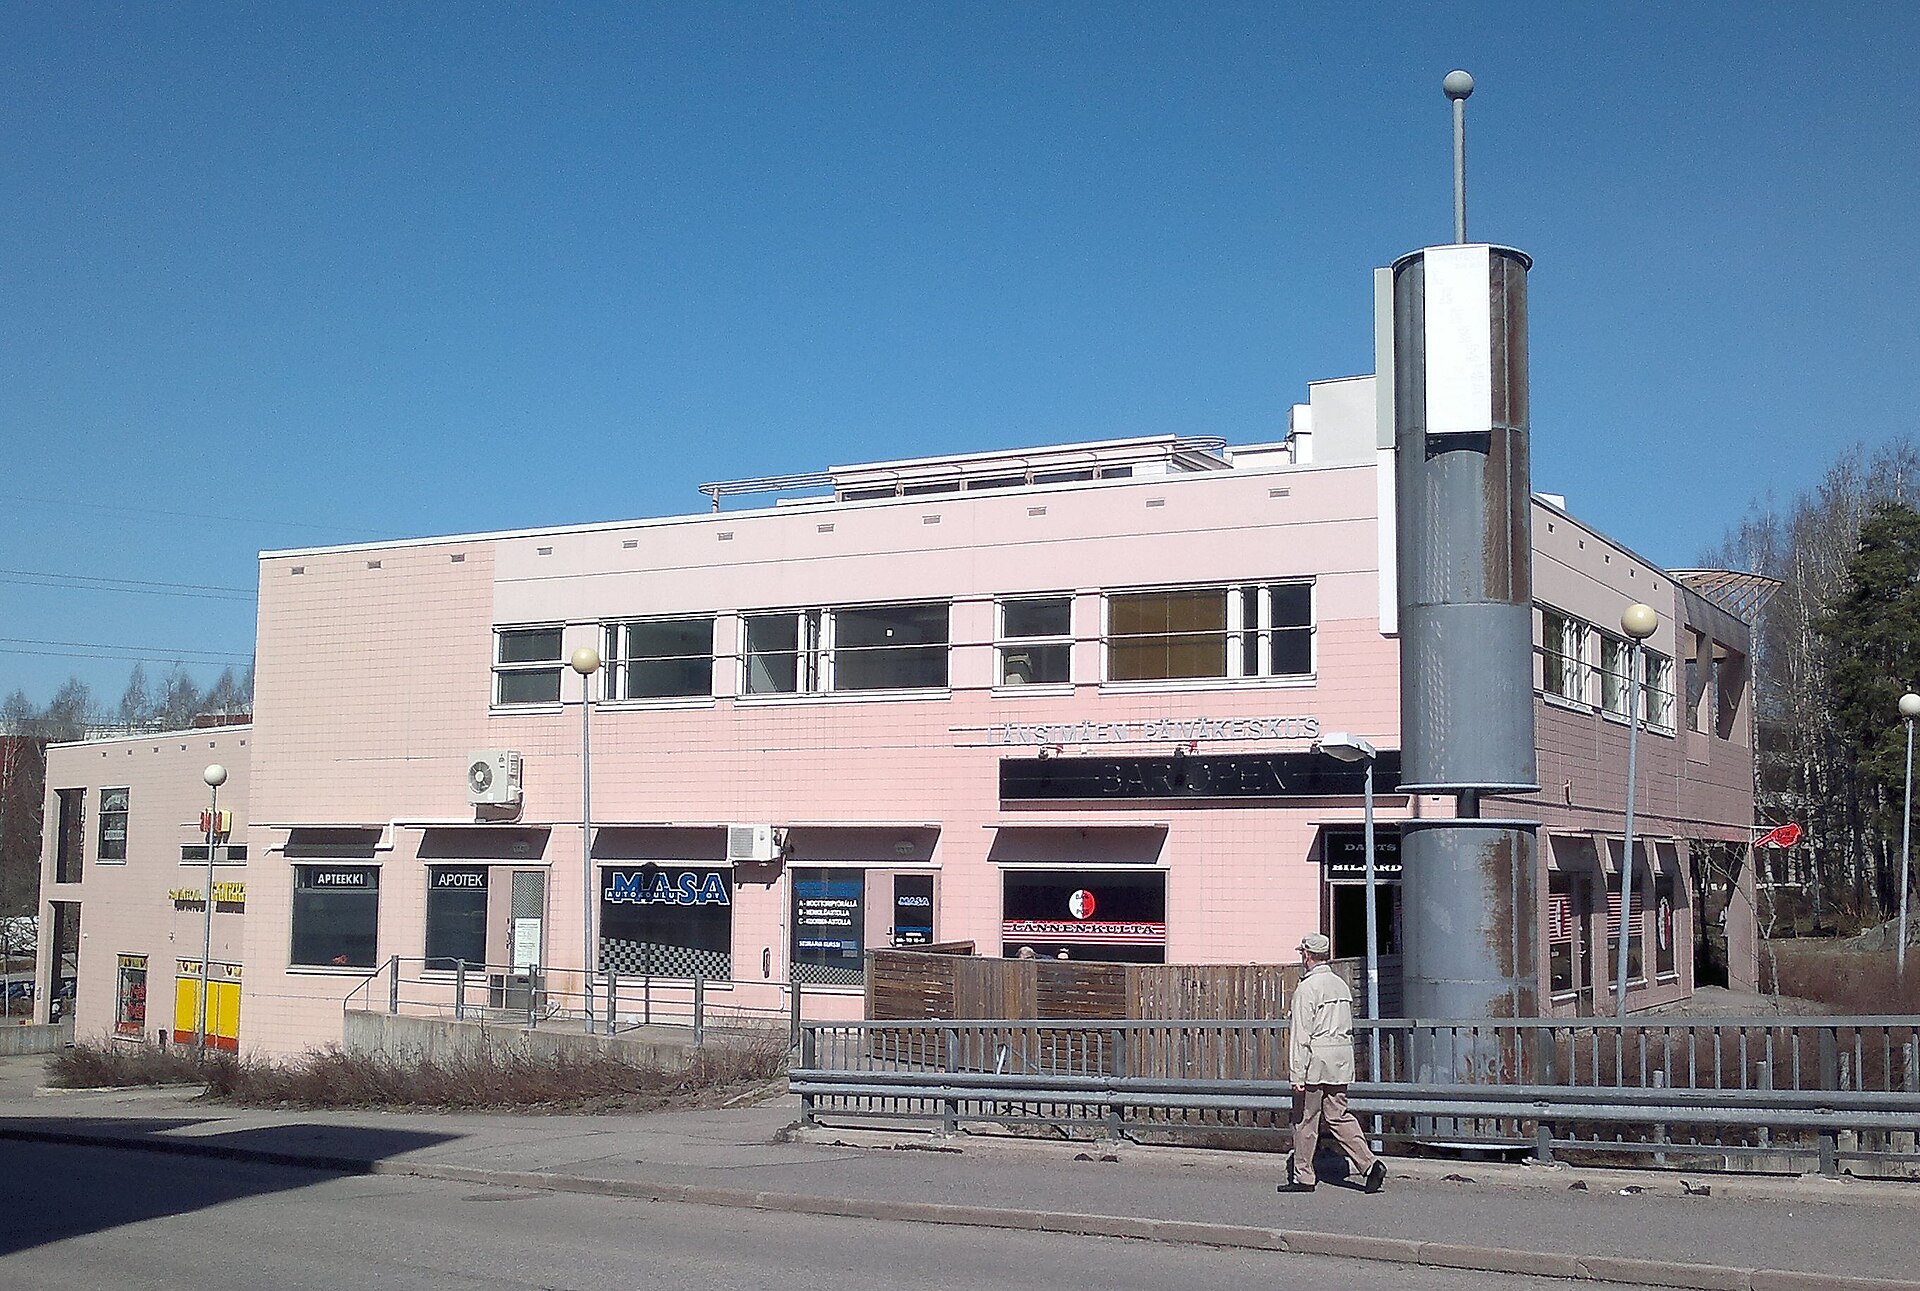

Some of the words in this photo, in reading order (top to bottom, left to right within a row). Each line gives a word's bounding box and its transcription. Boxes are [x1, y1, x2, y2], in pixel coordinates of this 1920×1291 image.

[1143, 717, 1320, 740] PÄIVÄKESKUS
[317, 873, 363, 885] APTEEKKI
[438, 873, 483, 887] APOTEK
[607, 890, 674, 899] AUTOKOULU
[706, 891, 719, 899] OY
[612, 872, 731, 905] MASA
